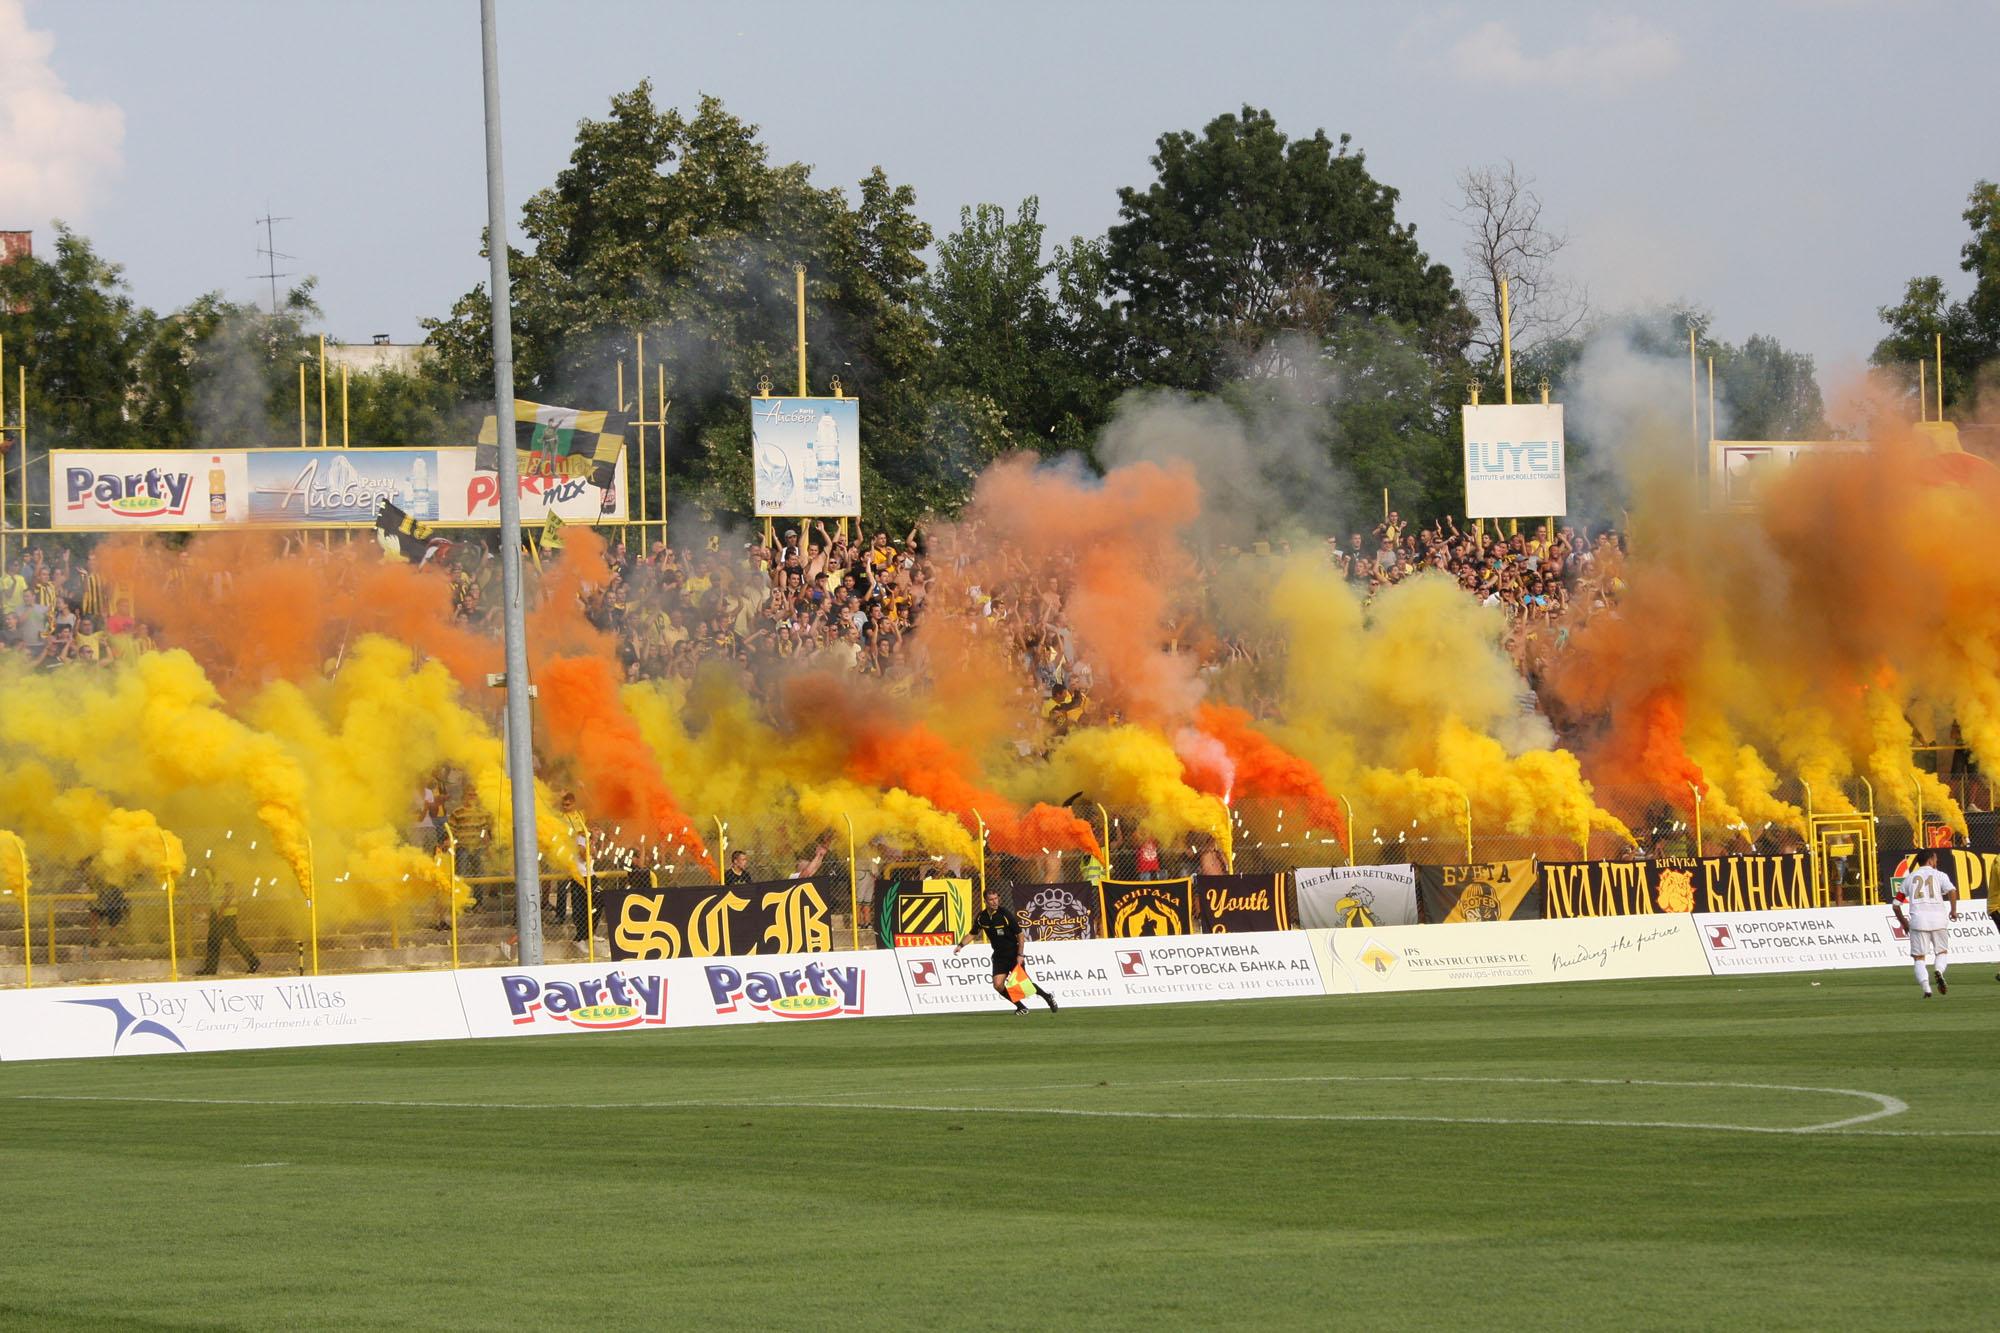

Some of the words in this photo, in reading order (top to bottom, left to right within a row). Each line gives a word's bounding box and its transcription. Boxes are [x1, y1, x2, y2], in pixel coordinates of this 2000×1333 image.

[66, 467, 192, 515] Party
[255, 458, 400, 517] Айсберг
[361, 477, 395, 490] Party
[118, 499, 159, 507] CLUB
[1300, 877, 1319, 890] THE
[1319, 871, 1342, 884] EVIL
[1343, 869, 1362, 879] HAS
[1362, 868, 1414, 886] RETURNED
[1442, 863, 1512, 887] БУНТА
[1703, 853, 1815, 913] БАНДА
[1911, 875, 1935, 900] 21
[1206, 888, 1270, 919] Youth
[615, 882, 832, 961] SCB
[1735, 919, 1835, 935] КОРПОРАТИВНА
[895, 934, 954, 948] TITANS
[1552, 944, 1608, 973] Building
[1611, 935, 1634, 953] the
[1637, 925, 1681, 953] future
[1740, 935, 1817, 950] ТЪРГОВСКА
[1819, 933, 1861, 946] БАНКА
[1863, 931, 1883, 944] АД
[942, 953, 1056, 970] КОРПОВНА
[1149, 944, 1260, 961] КОРПОРАТИВНА
[1403, 947, 1421, 957] IPS
[1407, 954, 1507, 968] INFRASTRUCTURES
[1508, 952, 1529, 963] PLC
[1714, 952, 1796, 968] Клиентите
[1799, 953, 1816, 964] са
[1819, 952, 1839, 963] ни
[1842, 949, 1889, 961] скъпи
[1036, 969, 1084, 983] БАНКА
[1087, 967, 1109, 981] АД
[1154, 960, 1235, 977] ТЪРГОВСКА
[1240, 958, 1287, 973] БАНКА
[1290, 957, 1311, 972] АД
[1448, 966, 1534, 980] www.ips-infra.com
[704, 961, 865, 1015] Party
[1061, 985, 1114, 999] скъпи
[1124, 979, 1214, 996] Клиентите
[1217, 979, 1236, 991] са
[1240, 979, 1261, 990] ни
[1265, 977, 1317, 990] скъпи
[137, 991, 188, 1023] Bay
[200, 988, 265, 1013] View
[276, 983, 346, 1010] Villas
[501, 970, 668, 1025] Party
[779, 996, 829, 1009] CLUB
[578, 1005, 631, 1018] CLUB
[195, 1018, 240, 1034] Luxury
[241, 1015, 311, 1031] Apartments
[312, 1014, 321, 1027] &
[320, 1012, 358, 1027] Villas
